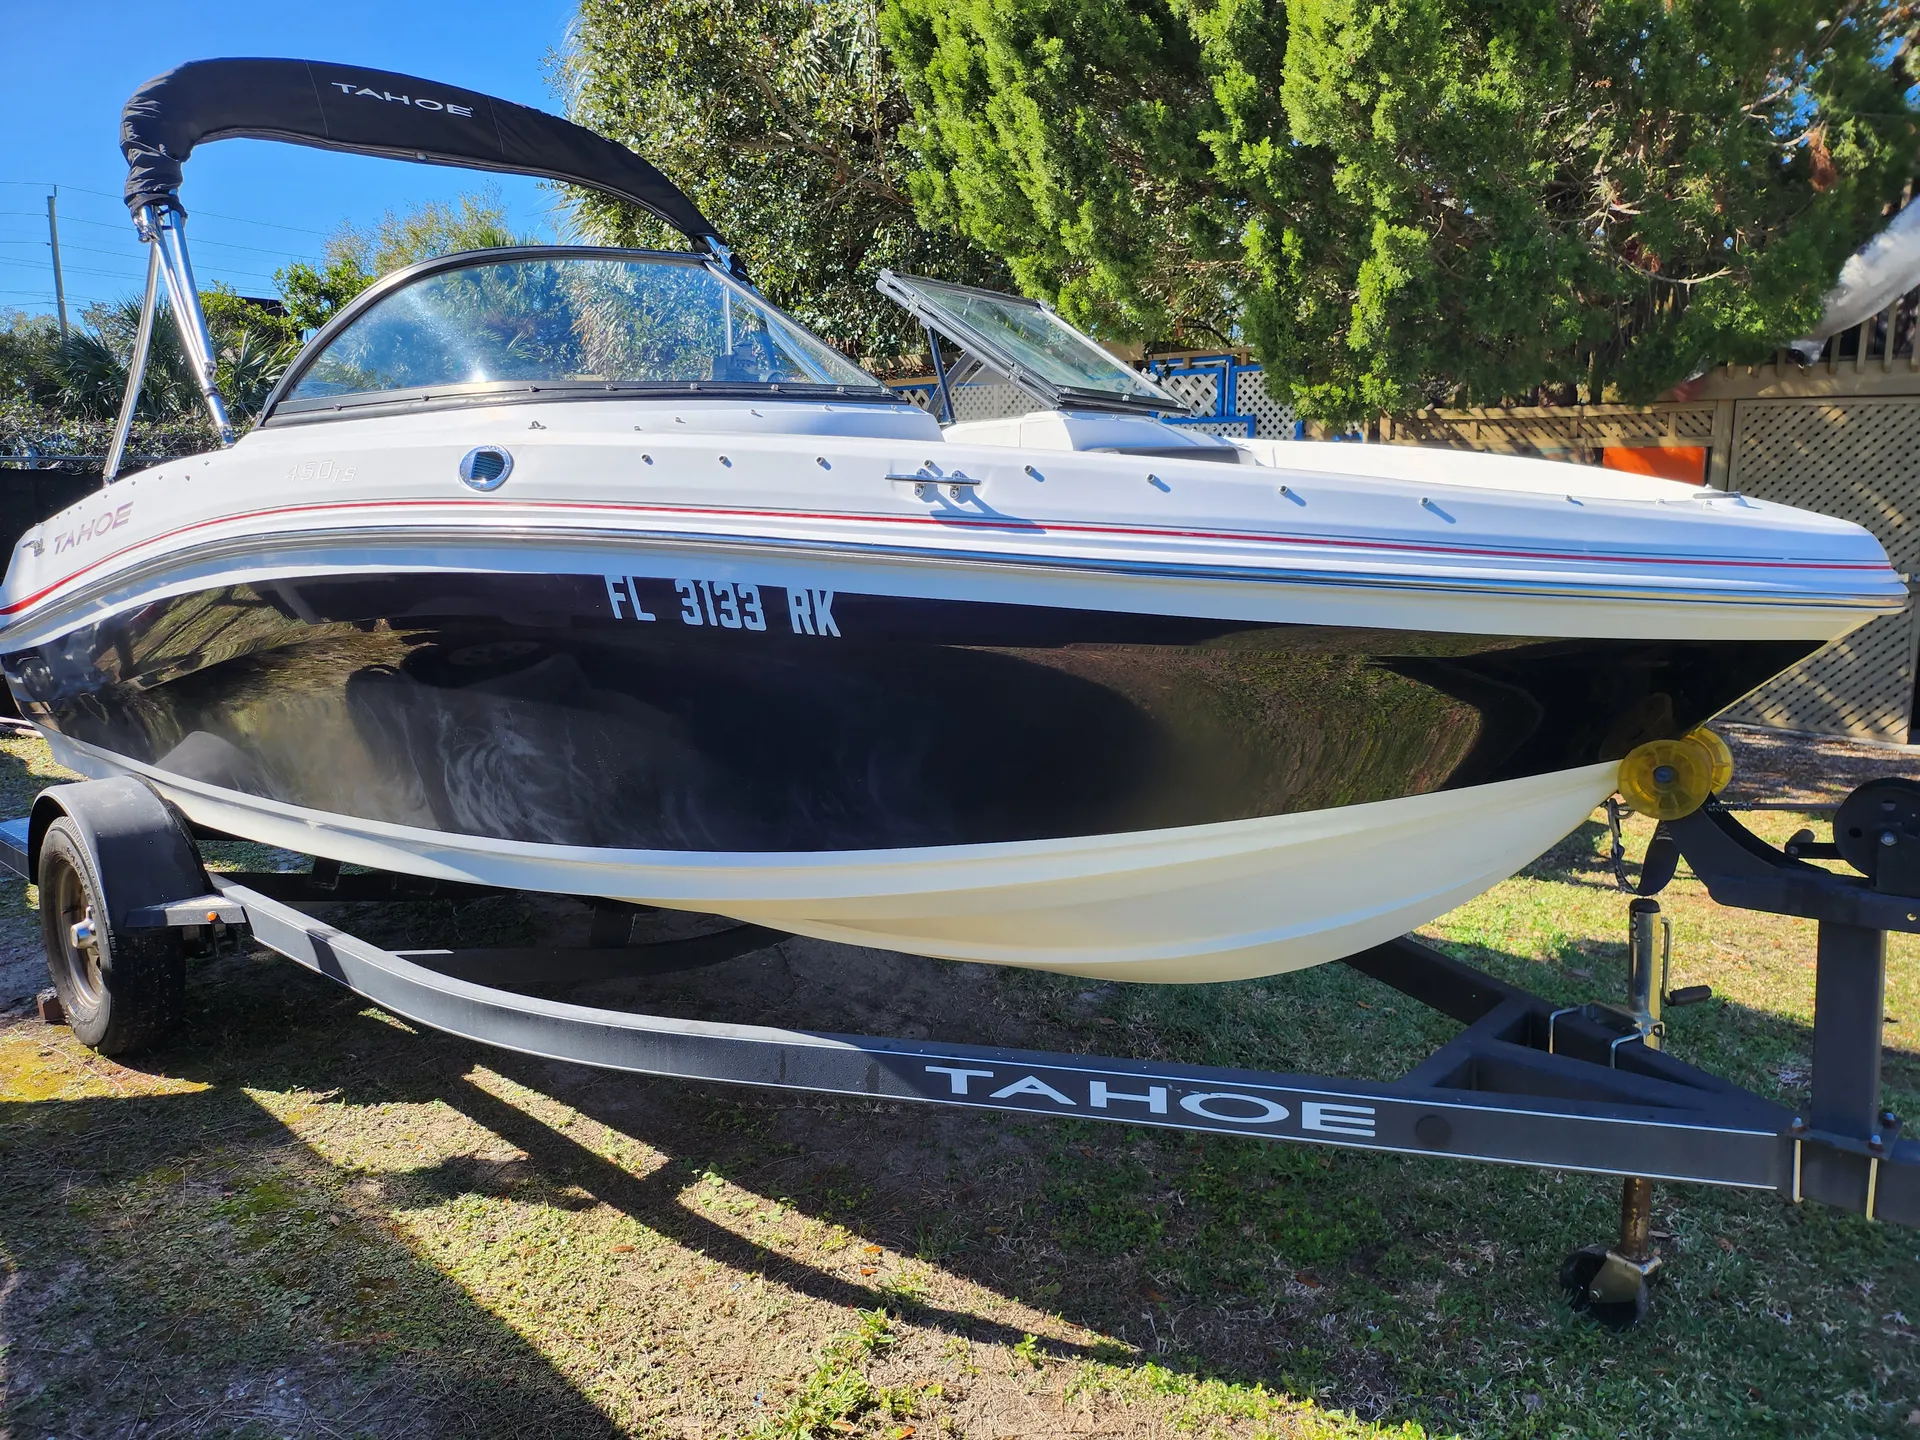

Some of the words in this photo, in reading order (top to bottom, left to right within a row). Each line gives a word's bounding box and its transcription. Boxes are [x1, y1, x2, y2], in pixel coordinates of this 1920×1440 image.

[331, 82, 473, 118] TAHOE
[54, 501, 134, 555] TAHOE
[604, 574, 656, 621] FL
[675, 578, 767, 632] 3133
[786, 587, 841, 637] RK
[925, 1065, 1376, 1137] TAHOE
